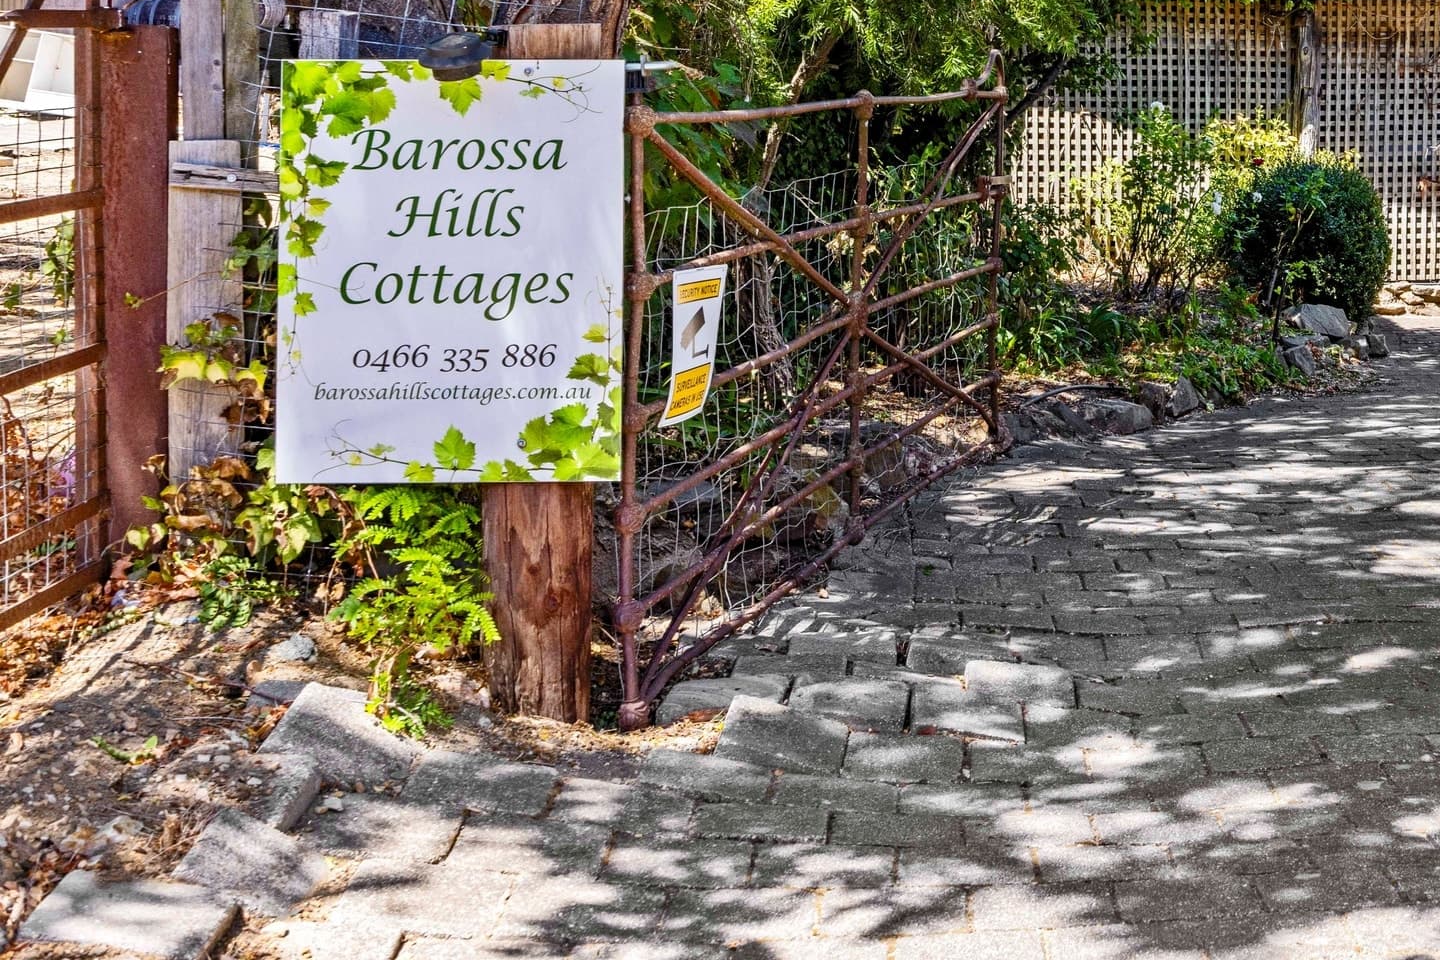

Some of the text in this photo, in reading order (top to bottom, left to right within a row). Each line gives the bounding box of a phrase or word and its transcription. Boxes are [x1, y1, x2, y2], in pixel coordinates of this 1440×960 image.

[351, 128, 568, 171] Barossa
[387, 188, 525, 238] Hills
[339, 261, 574, 321] Cottages
[700, 283, 718, 296] NOTICE
[352, 343, 558, 373] 0466 335 886
[313, 381, 592, 406] barossahillscottages.com.au
